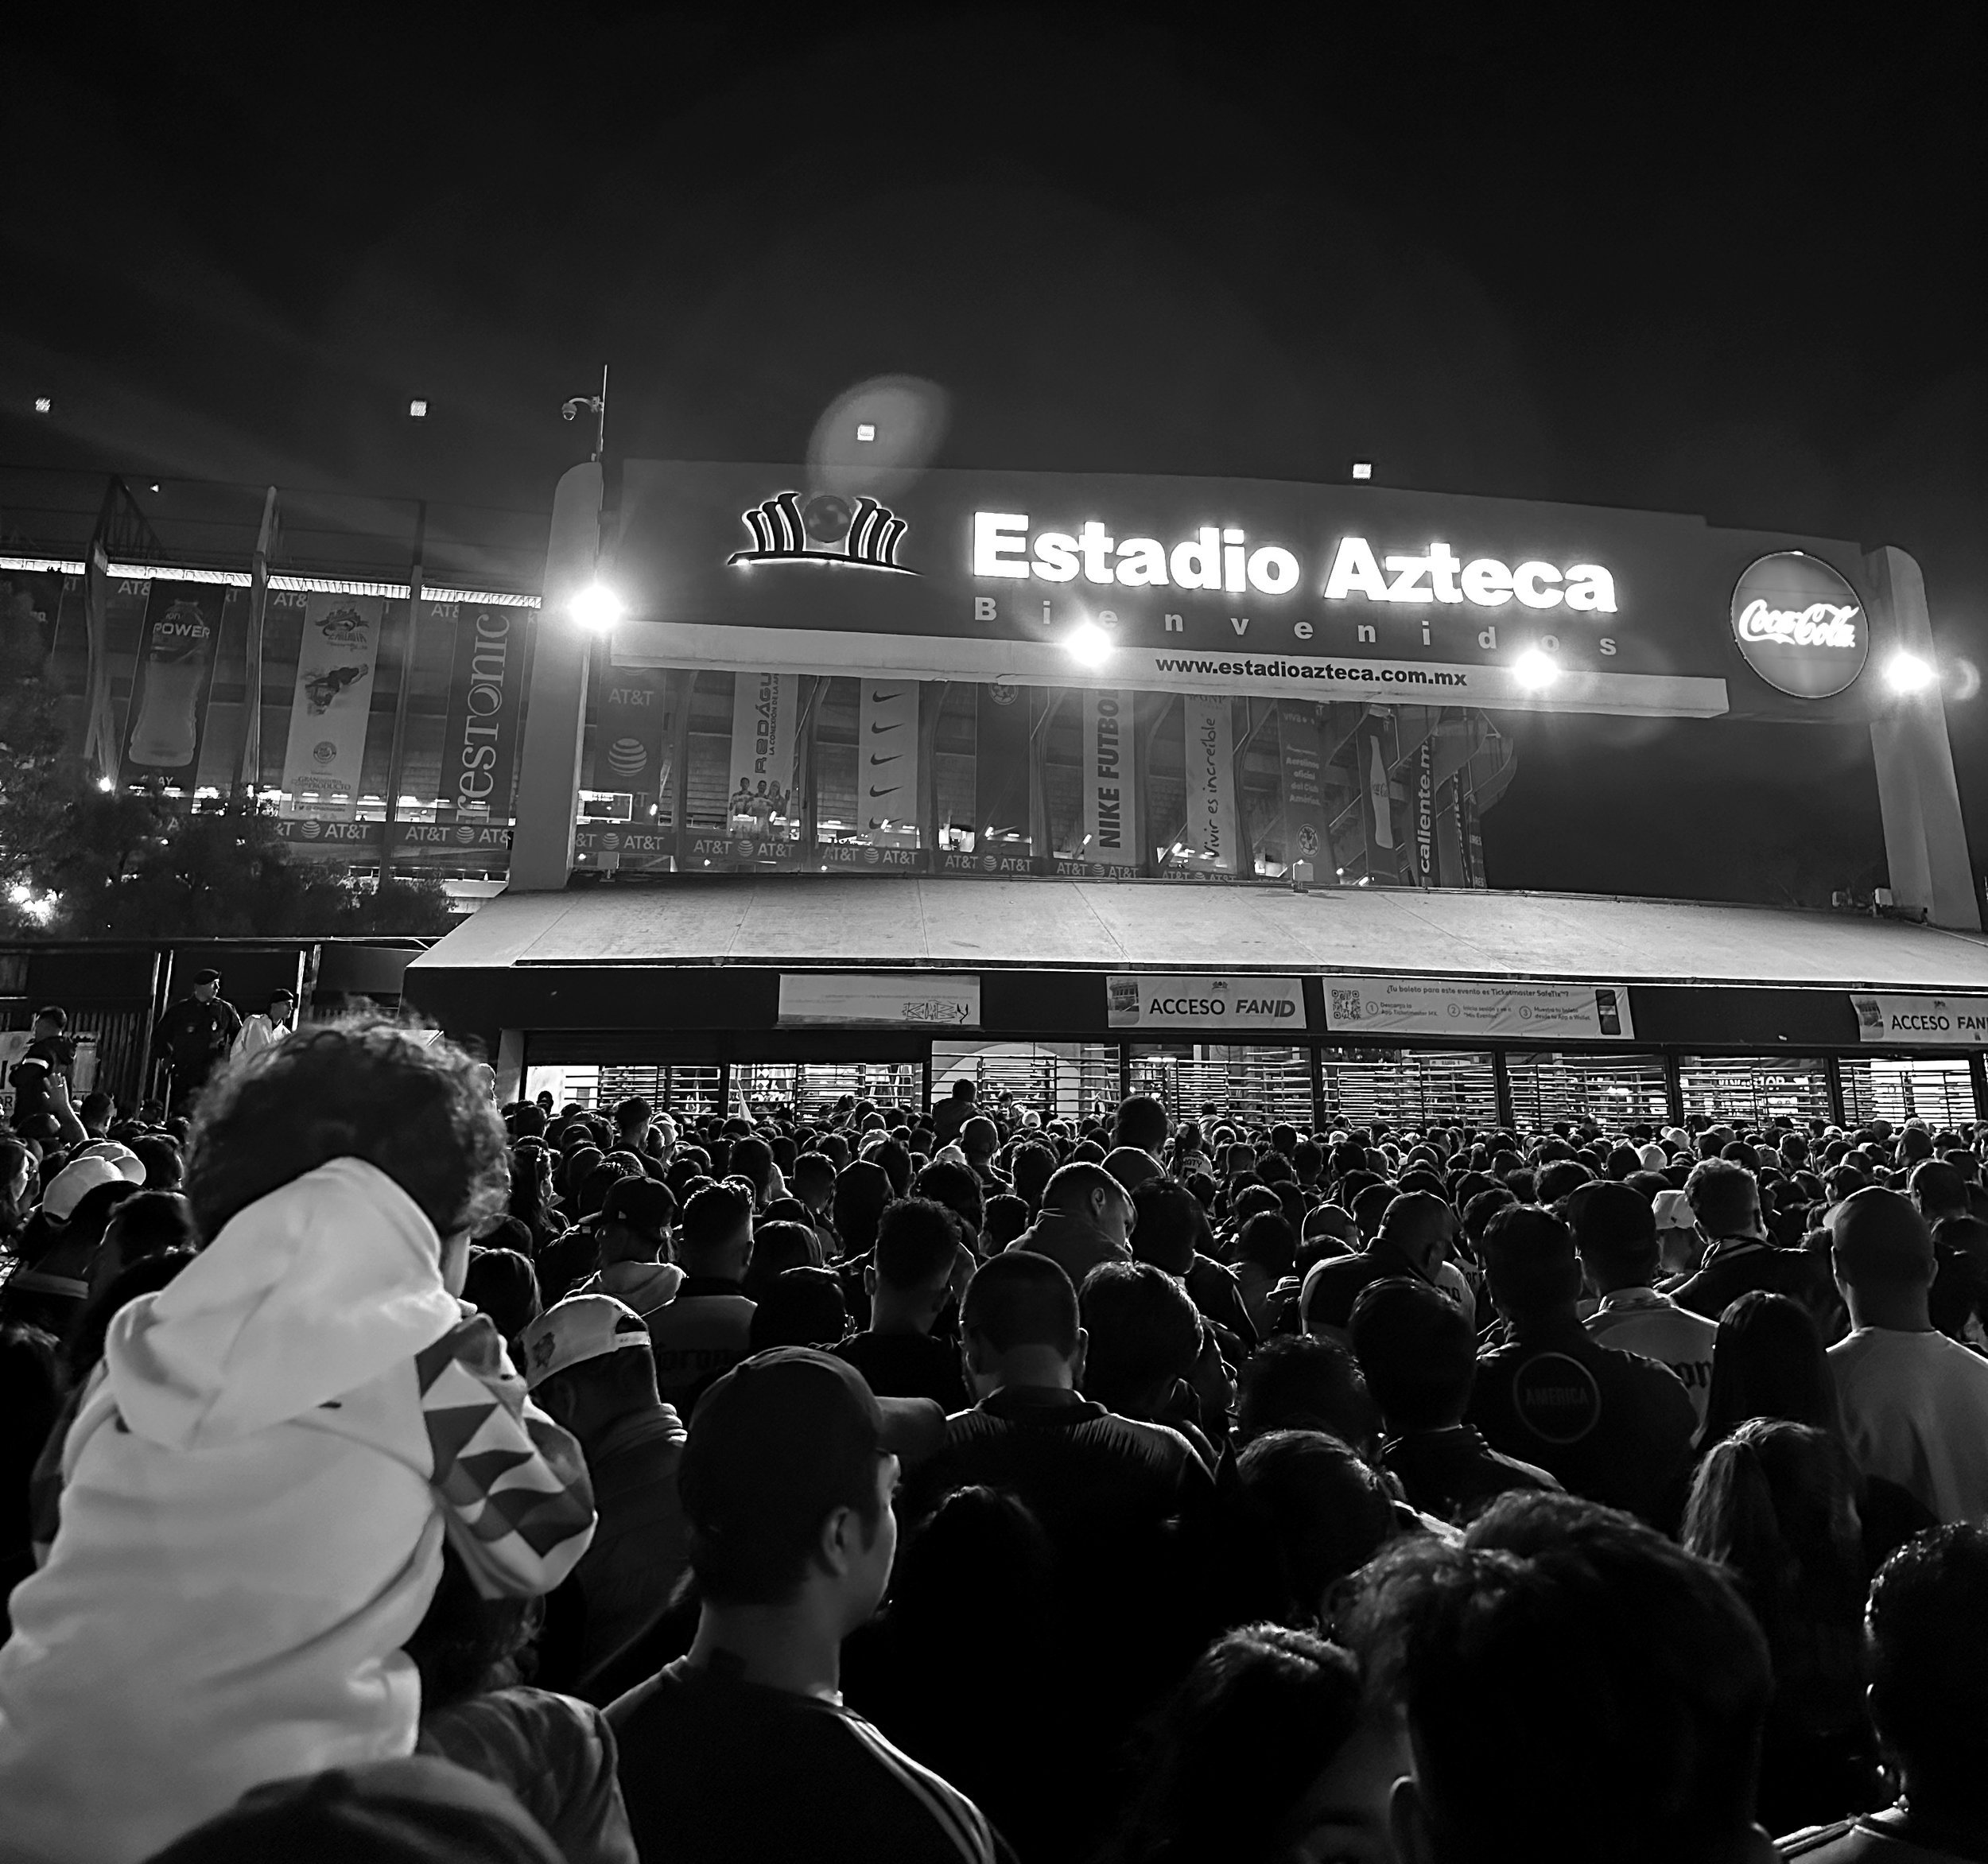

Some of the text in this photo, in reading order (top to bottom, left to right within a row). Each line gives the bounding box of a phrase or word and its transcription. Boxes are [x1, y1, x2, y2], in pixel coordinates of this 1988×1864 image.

[974, 512, 1618, 612] Estadio Azteca
[118, 580, 150, 596] AT&
[274, 592, 308, 608] AT&
[1155, 656, 1468, 686] www.estadioazteca.com.mx
[608, 689, 654, 705] AT&T
[1200, 717, 1217, 794] increíble
[1207, 798, 1219, 814] es
[1417, 740, 1431, 874] caliente.m
[1098, 787, 1121, 849] NIKE
[324, 823, 371, 840] AT&T
[405, 826, 452, 842] AT&T
[1201, 819, 1220, 857] Vivir
[623, 836, 665, 850] AT&T
[693, 840, 794, 856] AT&T AT&T
[822, 847, 918, 864] AT&T AT&T
[945, 855, 1033, 872] AT&T AT&T
[1057, 862, 1140, 880] AT&T AT&T
[1149, 999, 1225, 1015] ACCESO
[1892, 1015, 1988, 1031] ACCESO FAN
